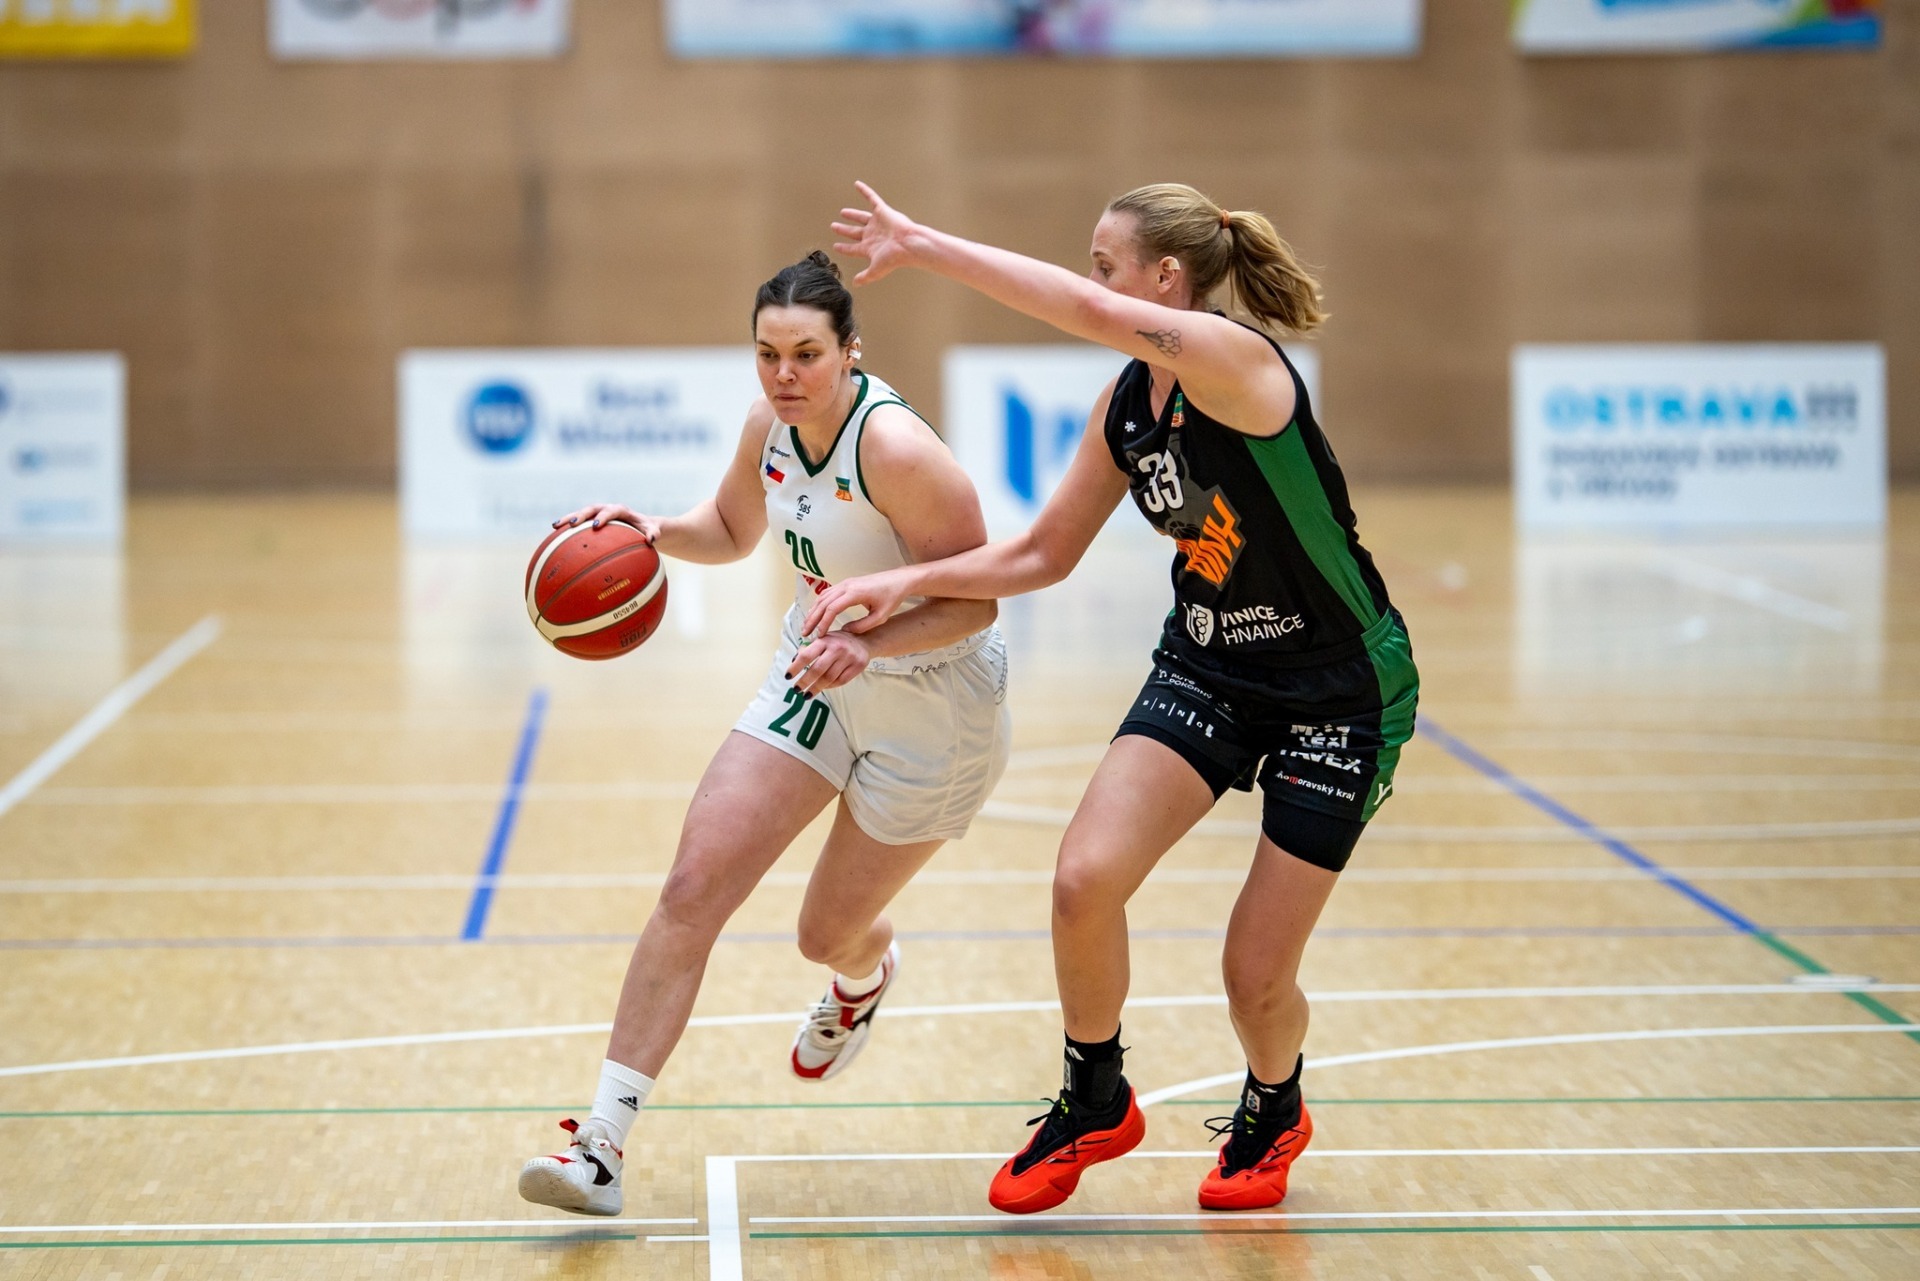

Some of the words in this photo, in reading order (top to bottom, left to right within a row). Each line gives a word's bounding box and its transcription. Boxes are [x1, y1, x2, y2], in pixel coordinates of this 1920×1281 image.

[1138, 449, 1184, 513] 33
[784, 528, 825, 578] 20
[1220, 604, 1280, 628] VINICE
[1222, 613, 1305, 646] HNANICE
[768, 687, 831, 751] 20
[1336, 787, 1356, 802] kraj
